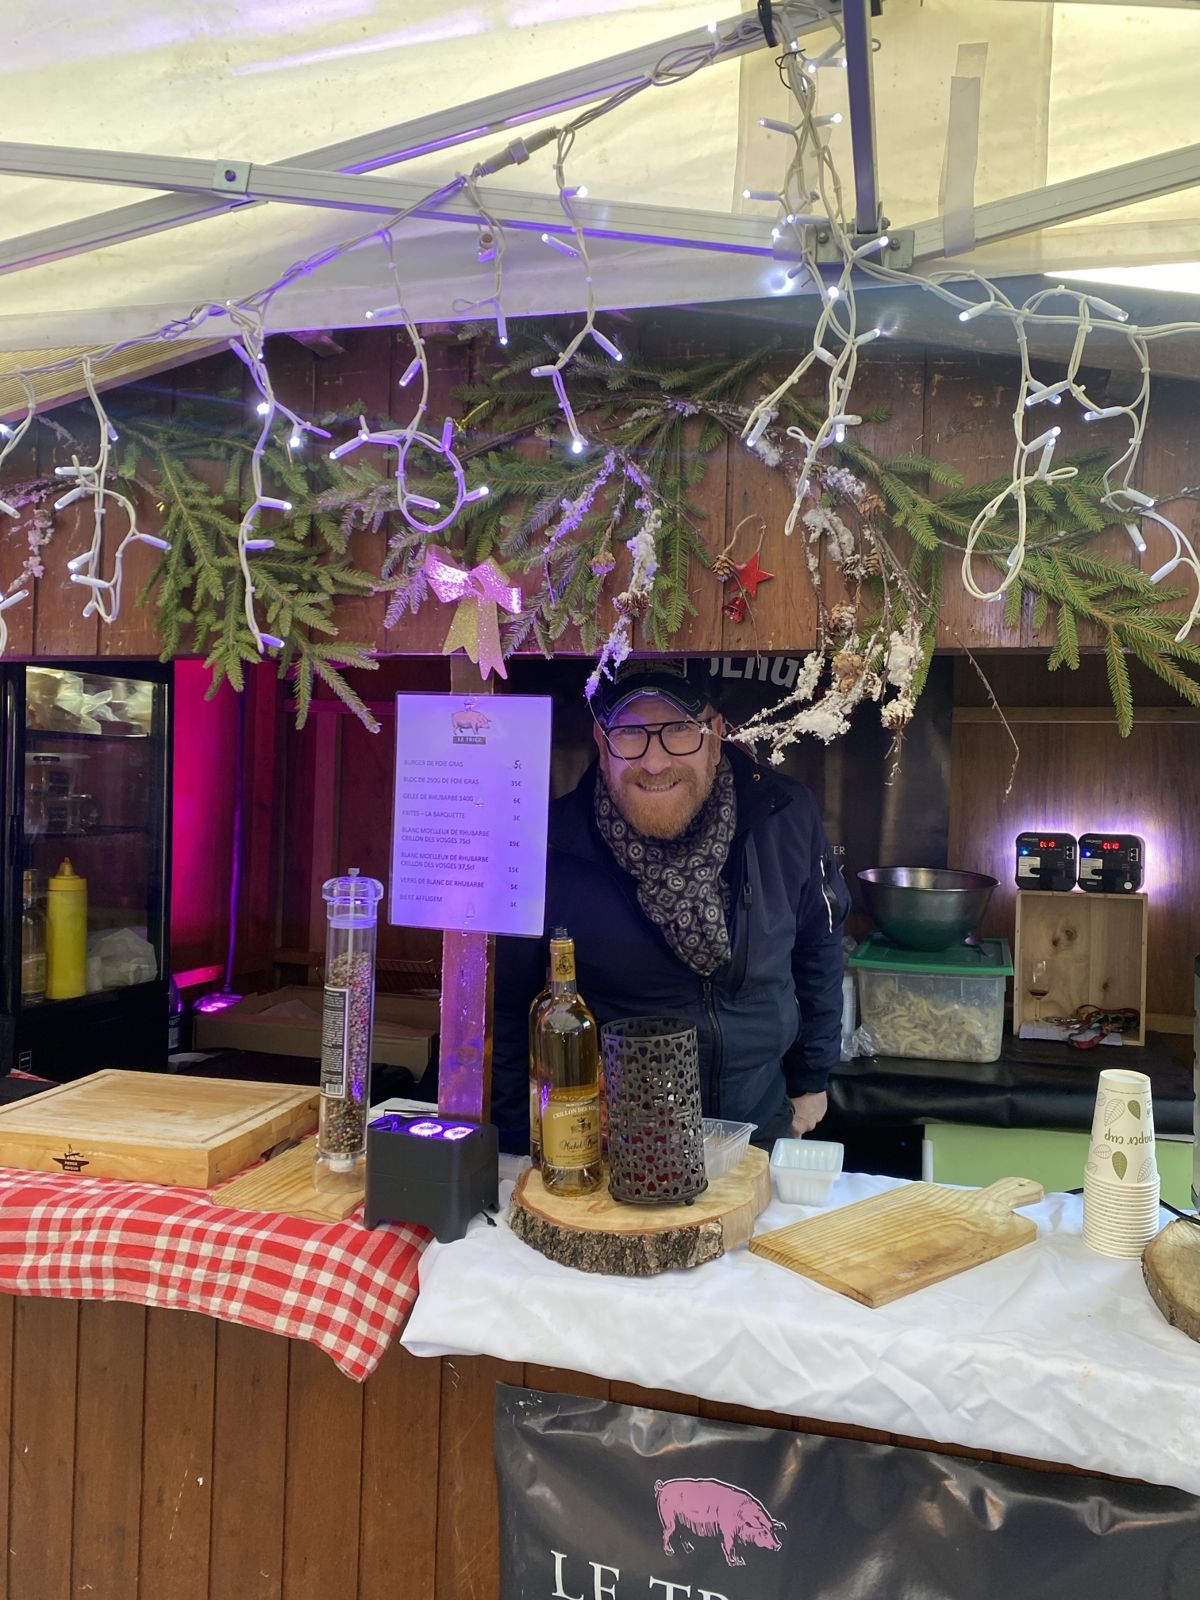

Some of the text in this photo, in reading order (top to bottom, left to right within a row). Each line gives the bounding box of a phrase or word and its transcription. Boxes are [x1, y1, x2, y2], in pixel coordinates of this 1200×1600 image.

[428, 794, 458, 802] RHUBARBE
[420, 827, 449, 835] MOELLEUX
[459, 829, 489, 837] RHUBARBE
[832, 845, 846, 856] ER
[458, 855, 489, 863] RHUBARBE
[435, 862, 457, 870] VOSGES
[426, 878, 445, 886] BLANC
[454, 880, 485, 888] RHUBARBE
[1104, 1128, 1125, 1145] cup
